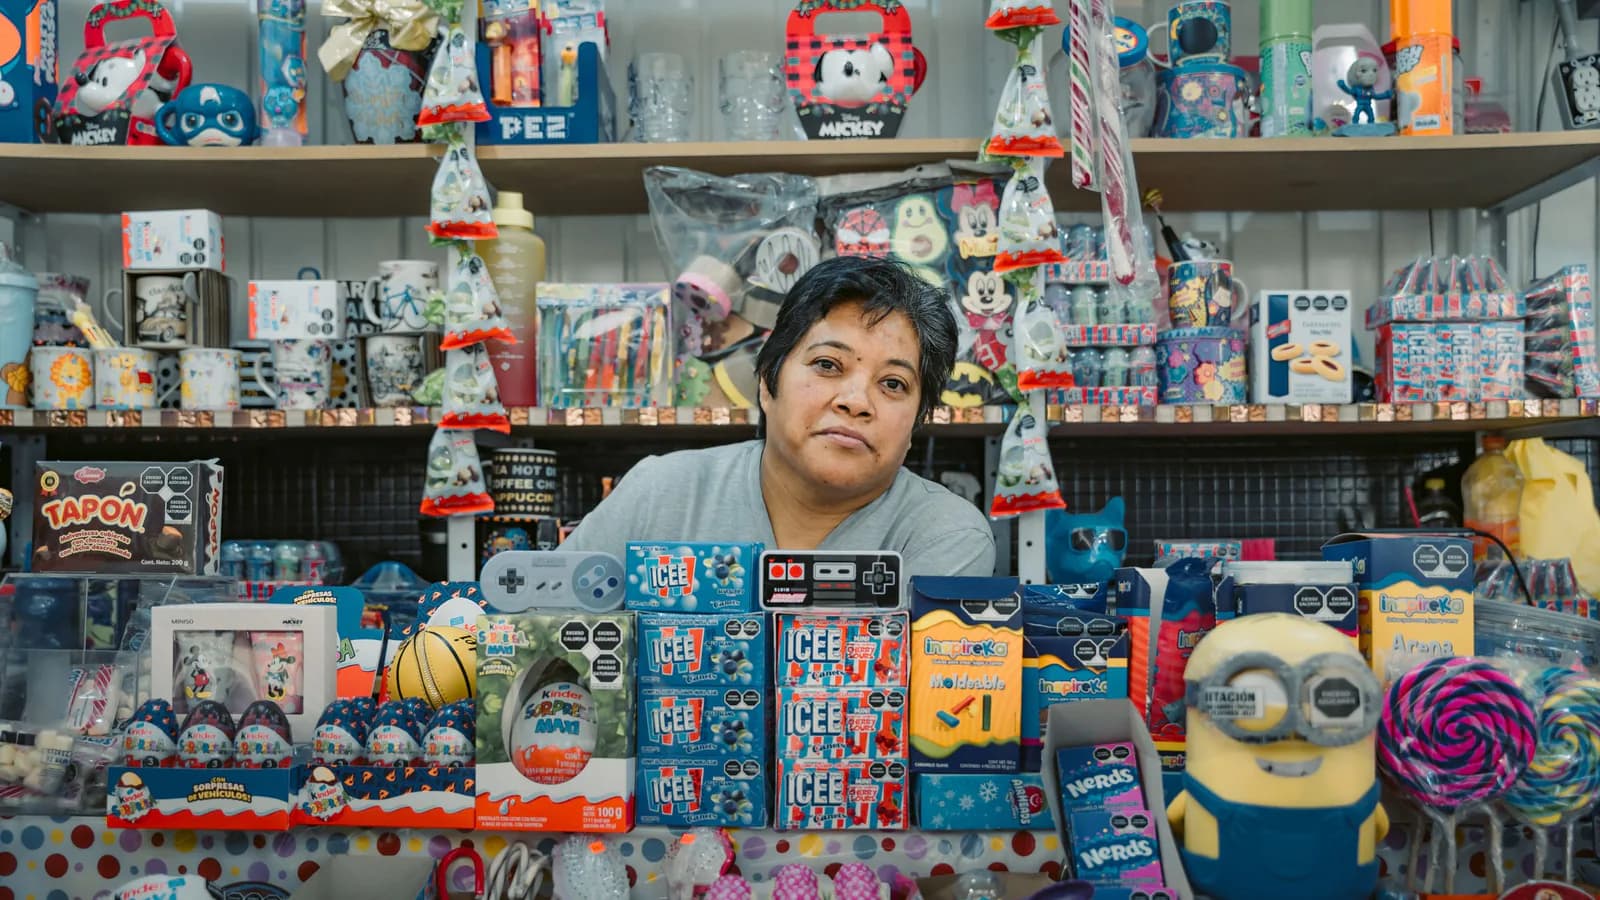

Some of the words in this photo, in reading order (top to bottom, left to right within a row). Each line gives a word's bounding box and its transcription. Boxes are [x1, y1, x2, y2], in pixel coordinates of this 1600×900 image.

[72, 127, 117, 146] MICKEY
[499, 115, 566, 139] PEZ
[818, 120, 884, 136] MICKEY
[512, 465, 542, 476] HOT
[650, 563, 689, 589] ICEE
[652, 635, 696, 664] ICEE
[785, 628, 842, 663] ICEE
[1392, 633, 1454, 657] Arena
[930, 672, 1006, 690] Moldeable
[542, 690, 582, 700] Kinder
[534, 718, 580, 735] MAXI
[652, 704, 696, 734] ICEE
[785, 701, 842, 736] ICEE
[193, 782, 244, 792] SORPRESAS
[311, 787, 337, 800] Kinder
[652, 774, 696, 804] ICEE
[786, 772, 843, 806] ICEE
[598, 807, 614, 817] 100
[615, 807, 622, 820] g
[1011, 779, 1031, 825] AIRHEADS
